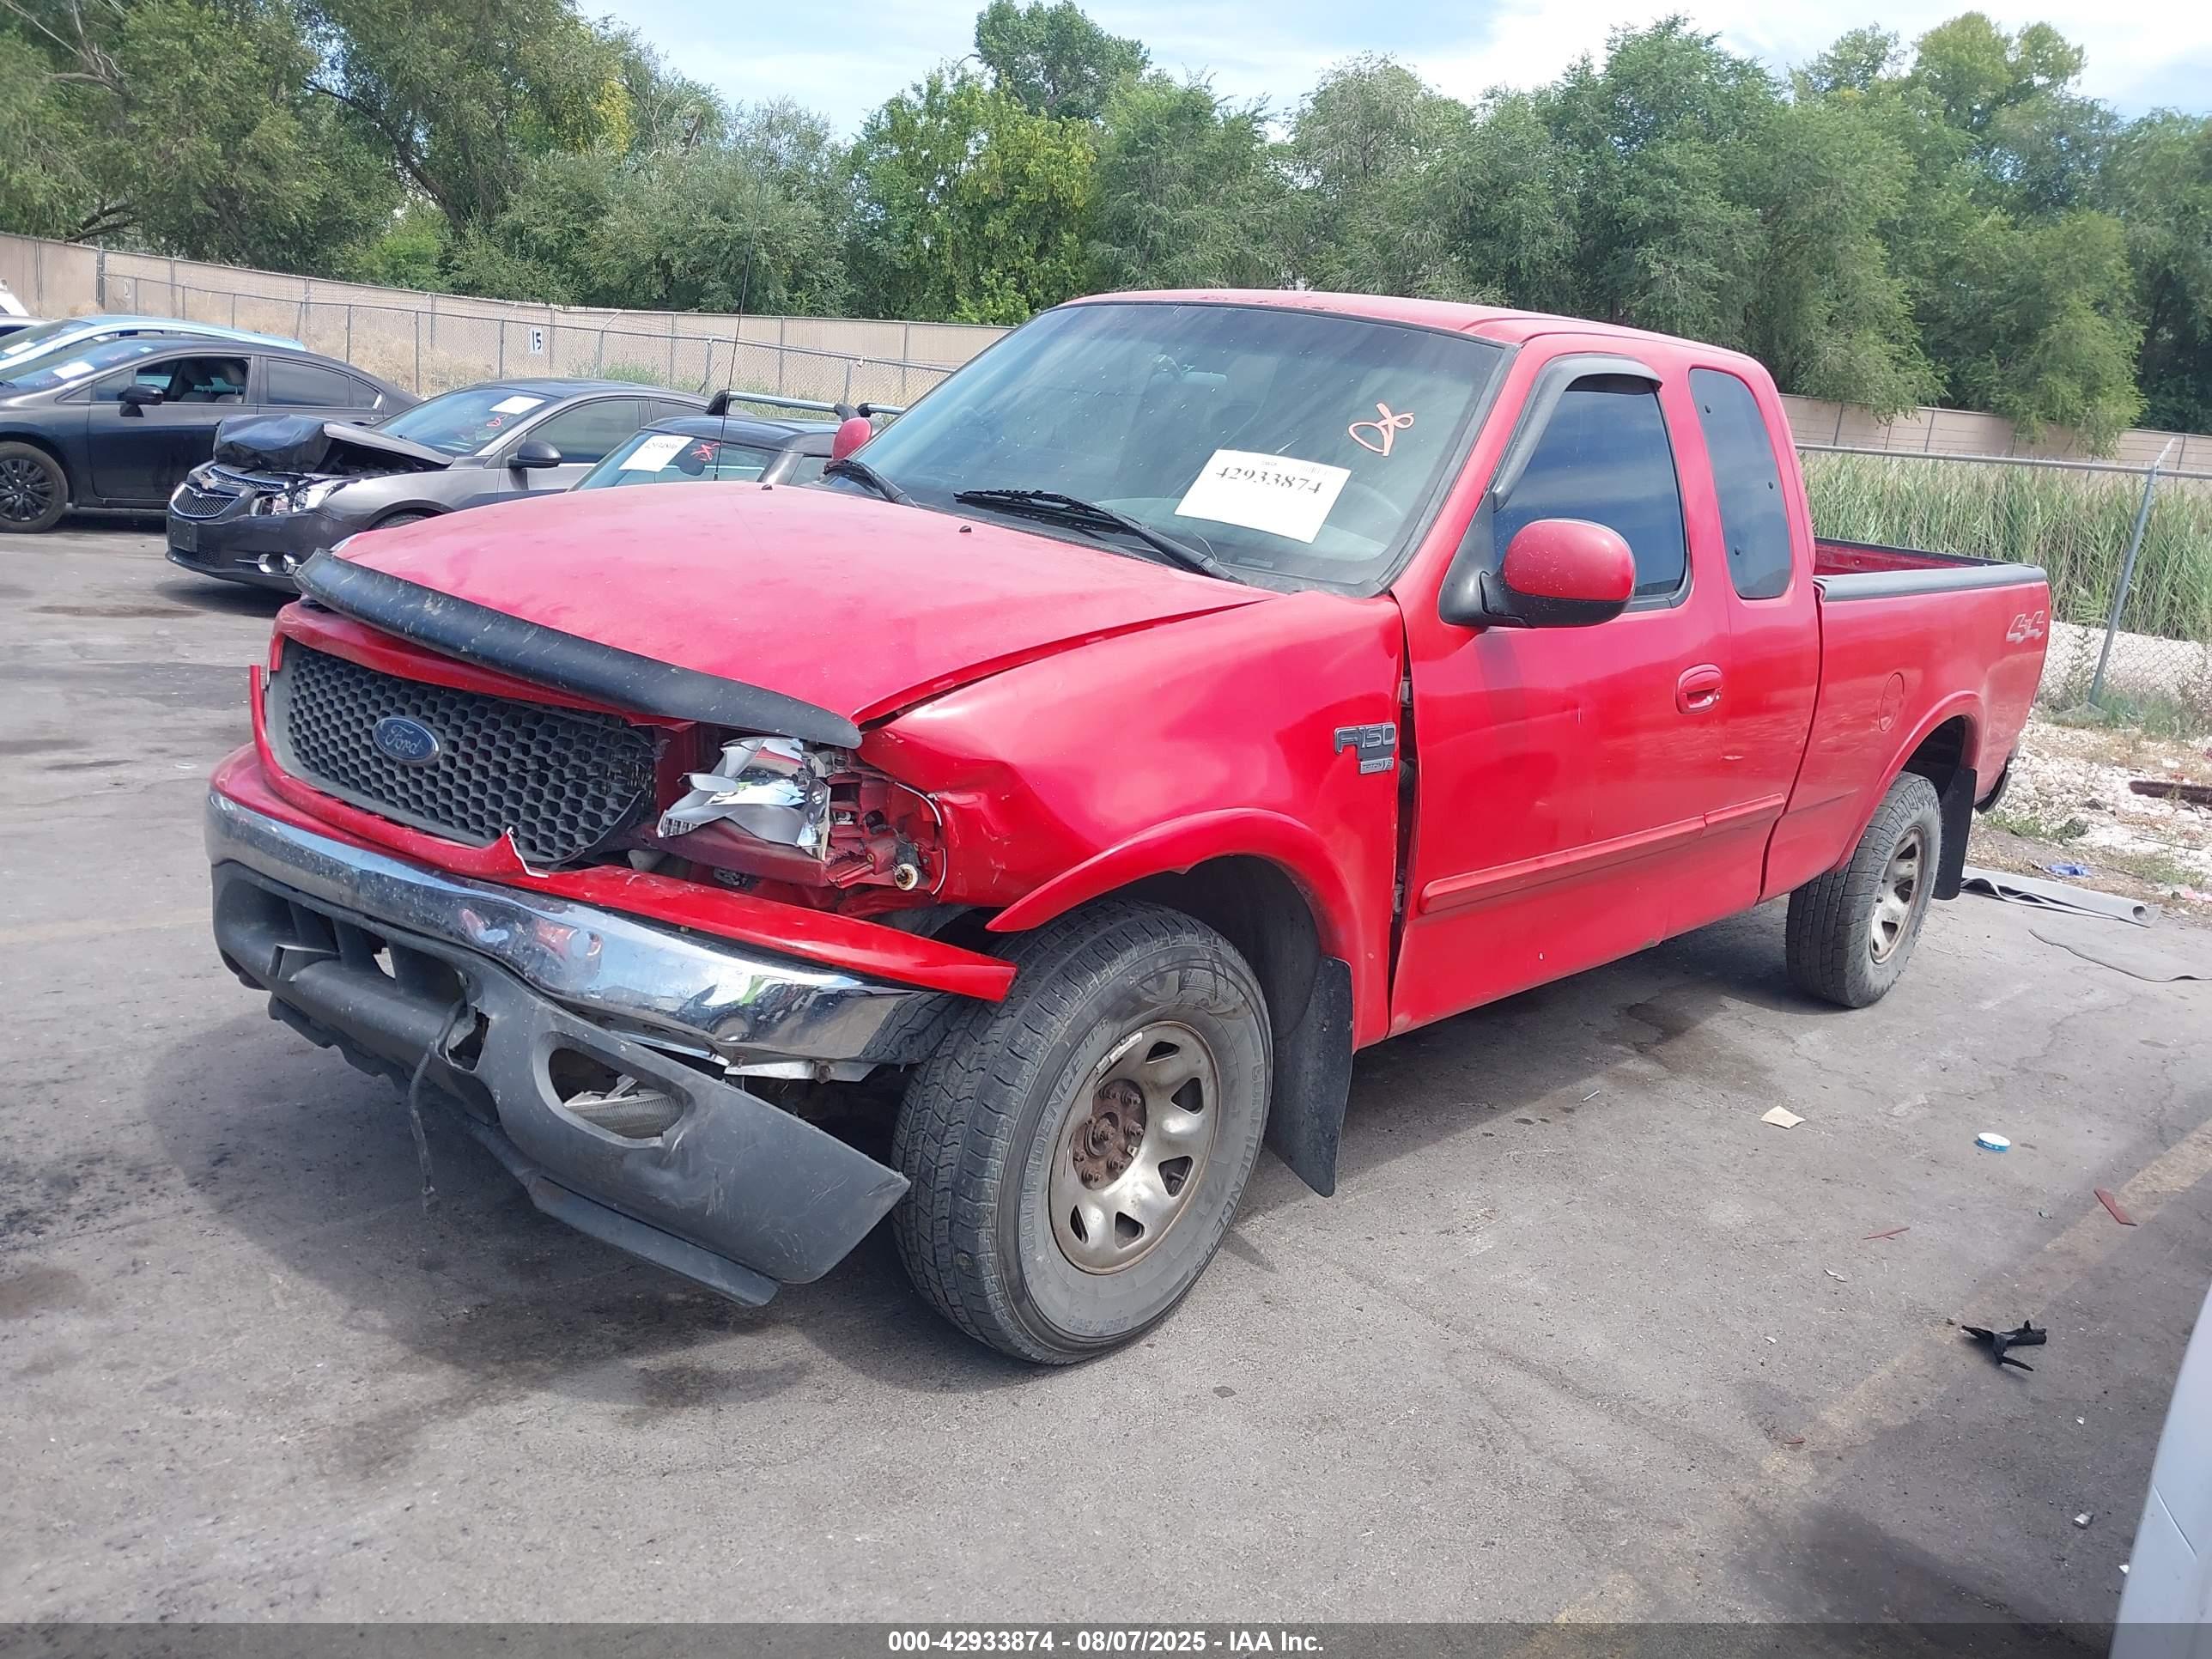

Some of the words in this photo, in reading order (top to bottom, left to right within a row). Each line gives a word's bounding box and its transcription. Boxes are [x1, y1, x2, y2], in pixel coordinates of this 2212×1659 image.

[532, 330, 543, 351] 15
[1215, 465, 1323, 495] 42933874
[384, 724, 422, 755] Ford
